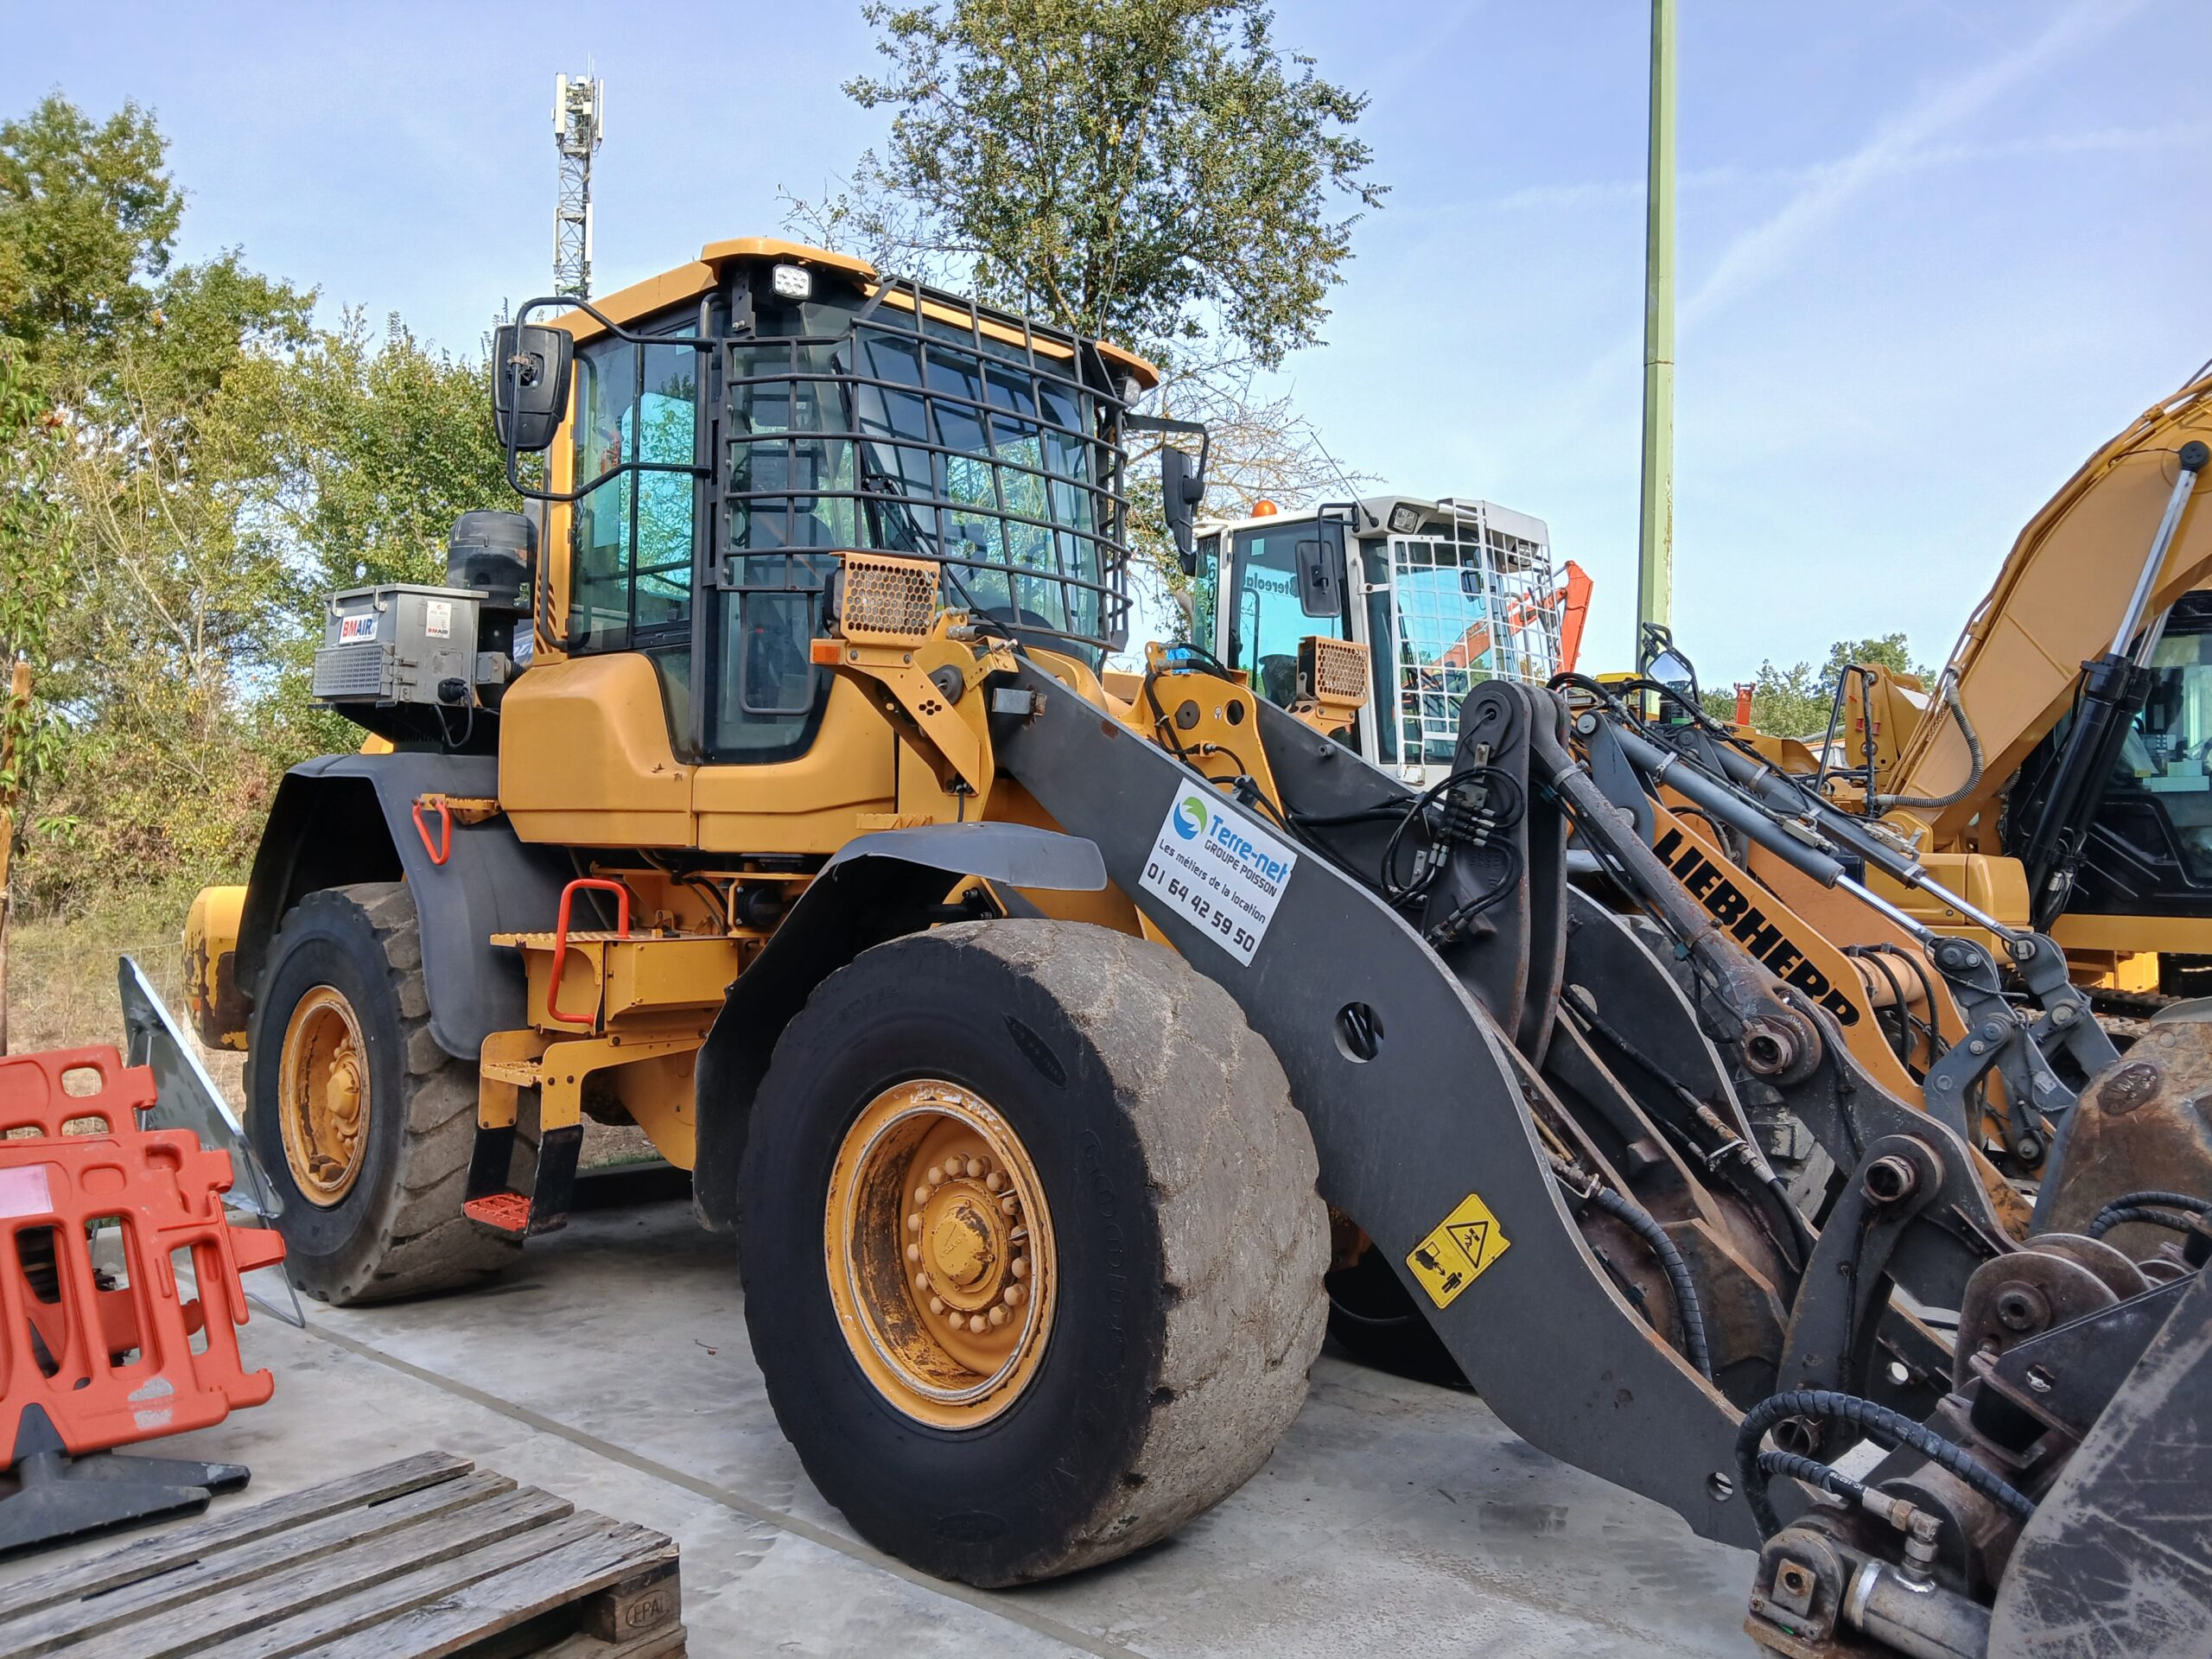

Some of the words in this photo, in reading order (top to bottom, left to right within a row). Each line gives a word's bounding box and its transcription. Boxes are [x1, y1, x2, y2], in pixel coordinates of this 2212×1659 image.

[342, 618, 372, 638] BMAIR
[1205, 562, 1217, 639] 6041
[1159, 838, 1174, 857] Les
[1176, 852, 1208, 880] métiers
[1209, 875, 1221, 890] de
[1221, 884, 1230, 898] la
[1230, 892, 1266, 925] location
[1204, 839, 1240, 871] GROUPE
[1239, 864, 1278, 898] POISSON
[1210, 815, 1288, 884] Terre-net
[1147, 862, 1166, 886] 01
[1167, 878, 1190, 902] 64
[1191, 895, 1211, 918] 42
[1211, 910, 1233, 935] 59
[1233, 925, 1255, 953] 50
[1652, 827, 1860, 1027] LIEBHERR
